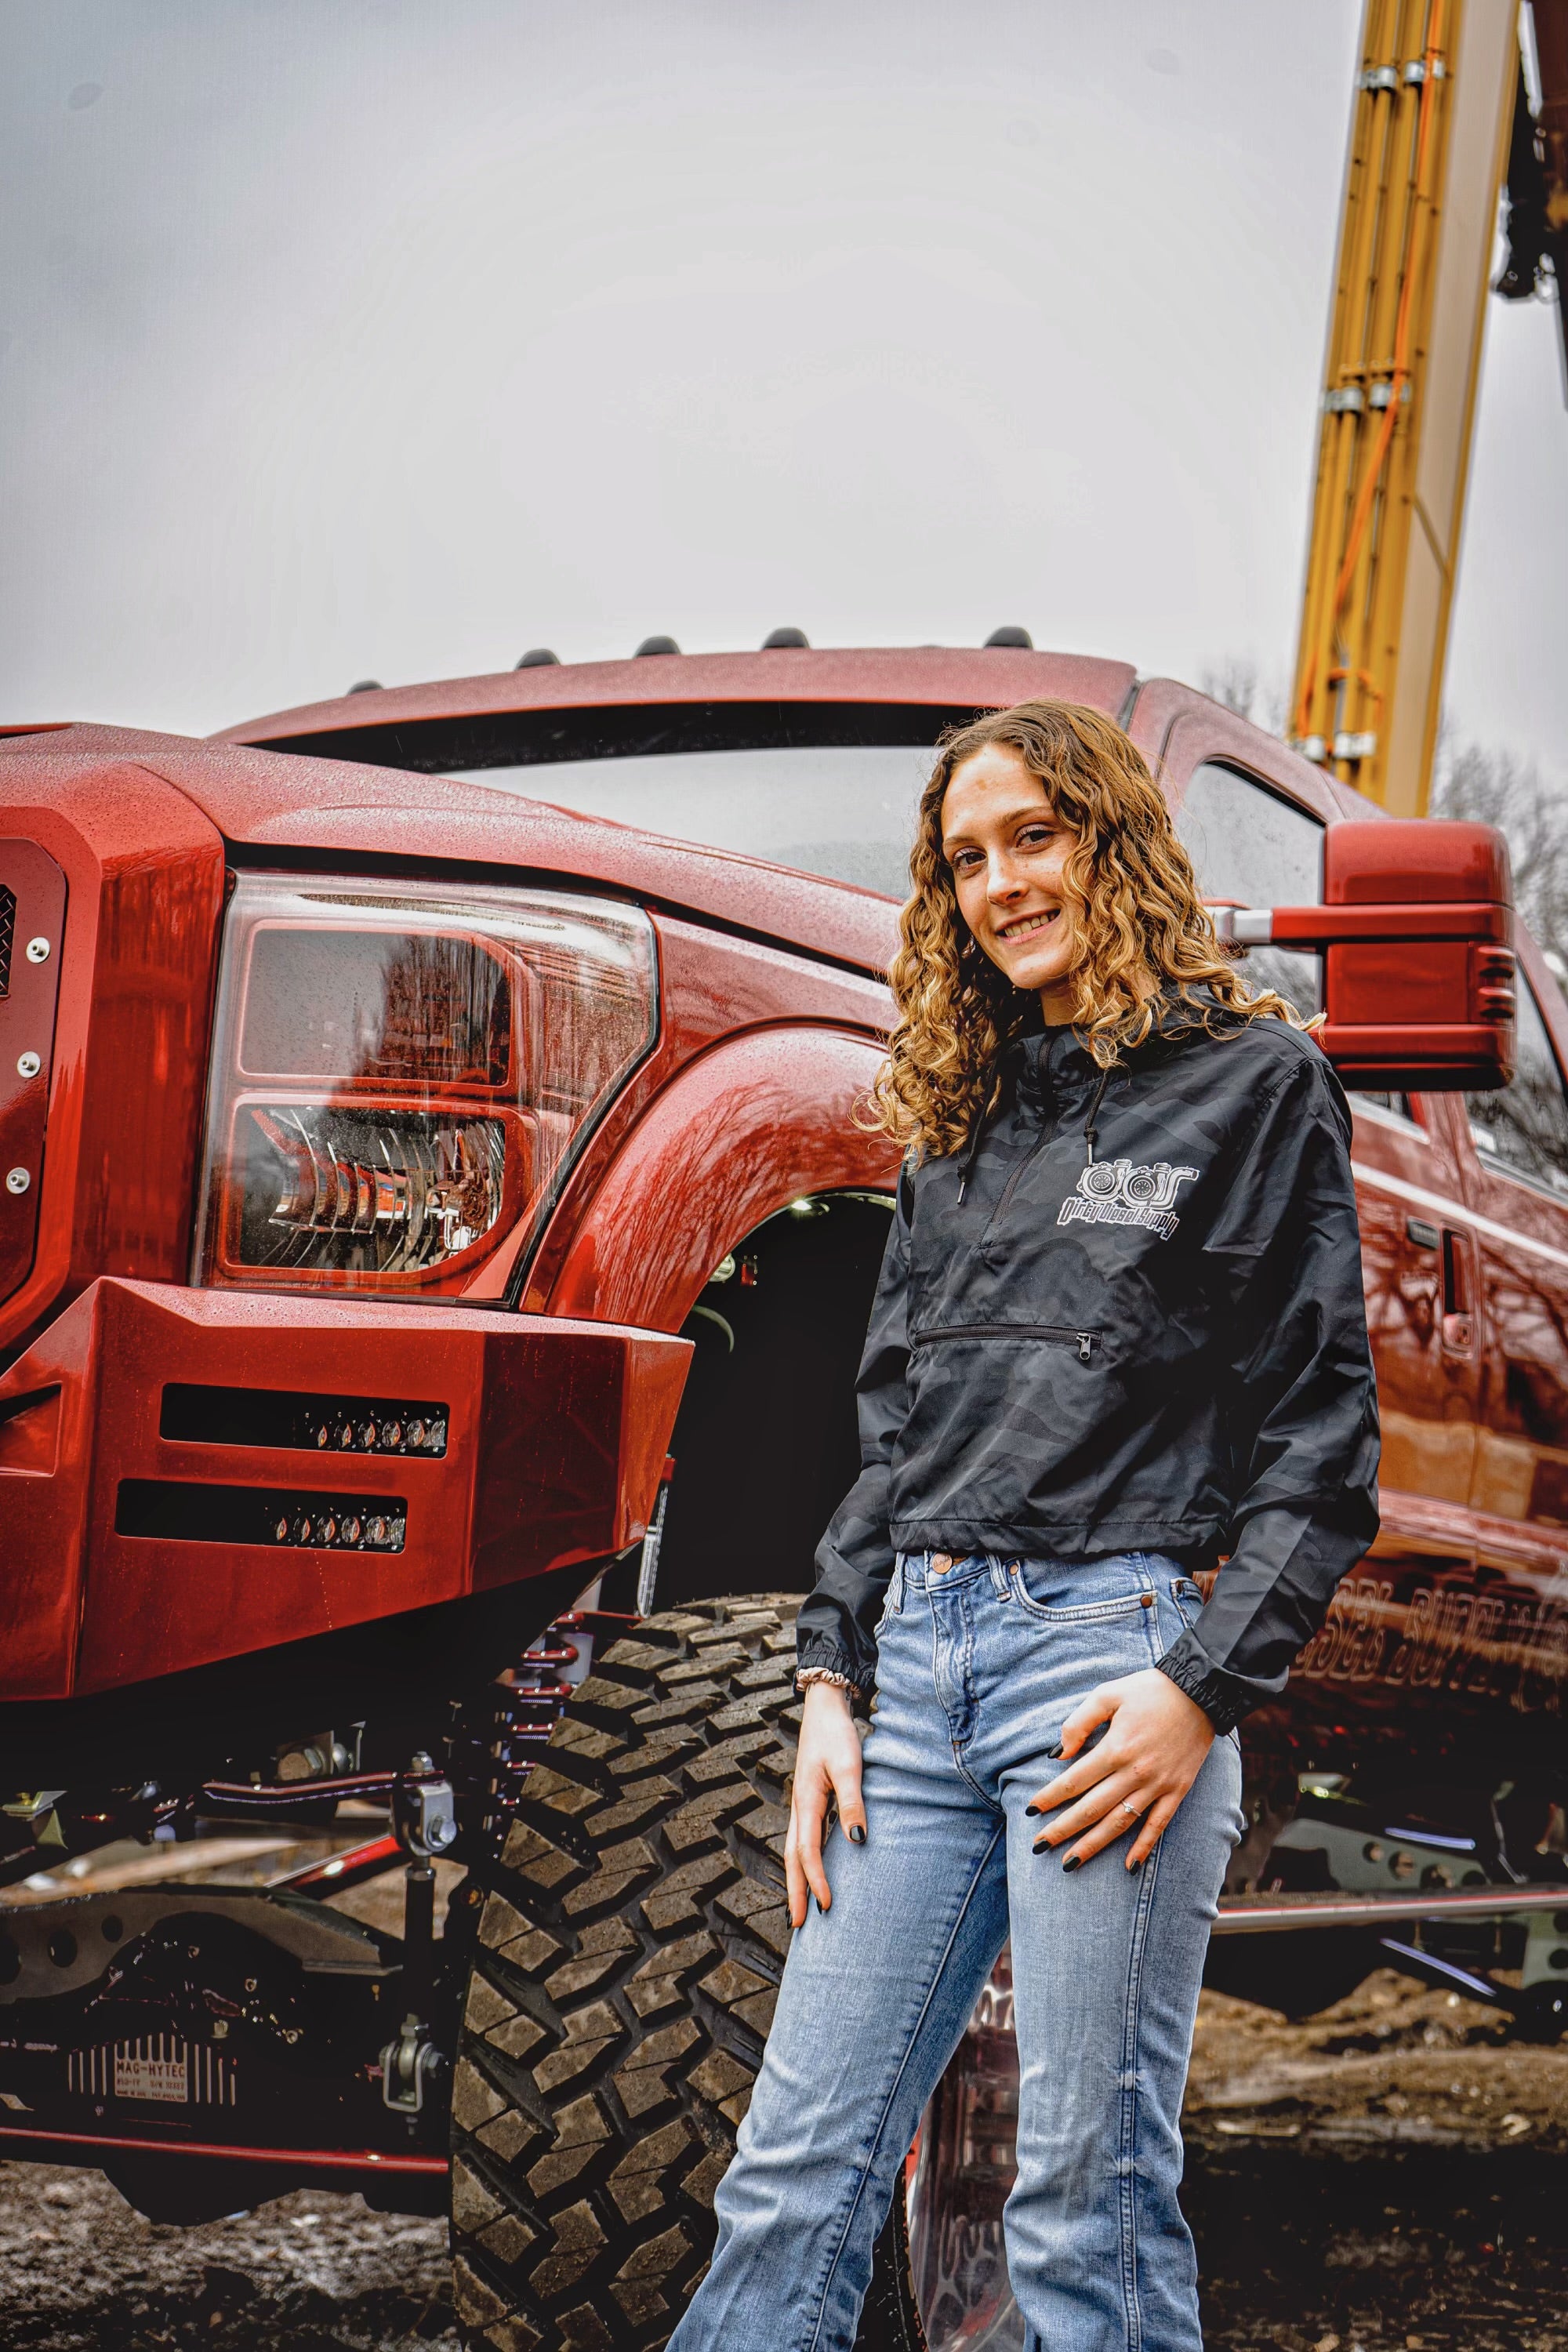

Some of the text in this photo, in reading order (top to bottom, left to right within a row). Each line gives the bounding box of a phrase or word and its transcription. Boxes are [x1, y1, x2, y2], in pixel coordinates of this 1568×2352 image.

[1057, 1196, 1179, 1240] Dirty Diesel Supply
[117, 2062, 184, 2077] MAG-HYTEC
